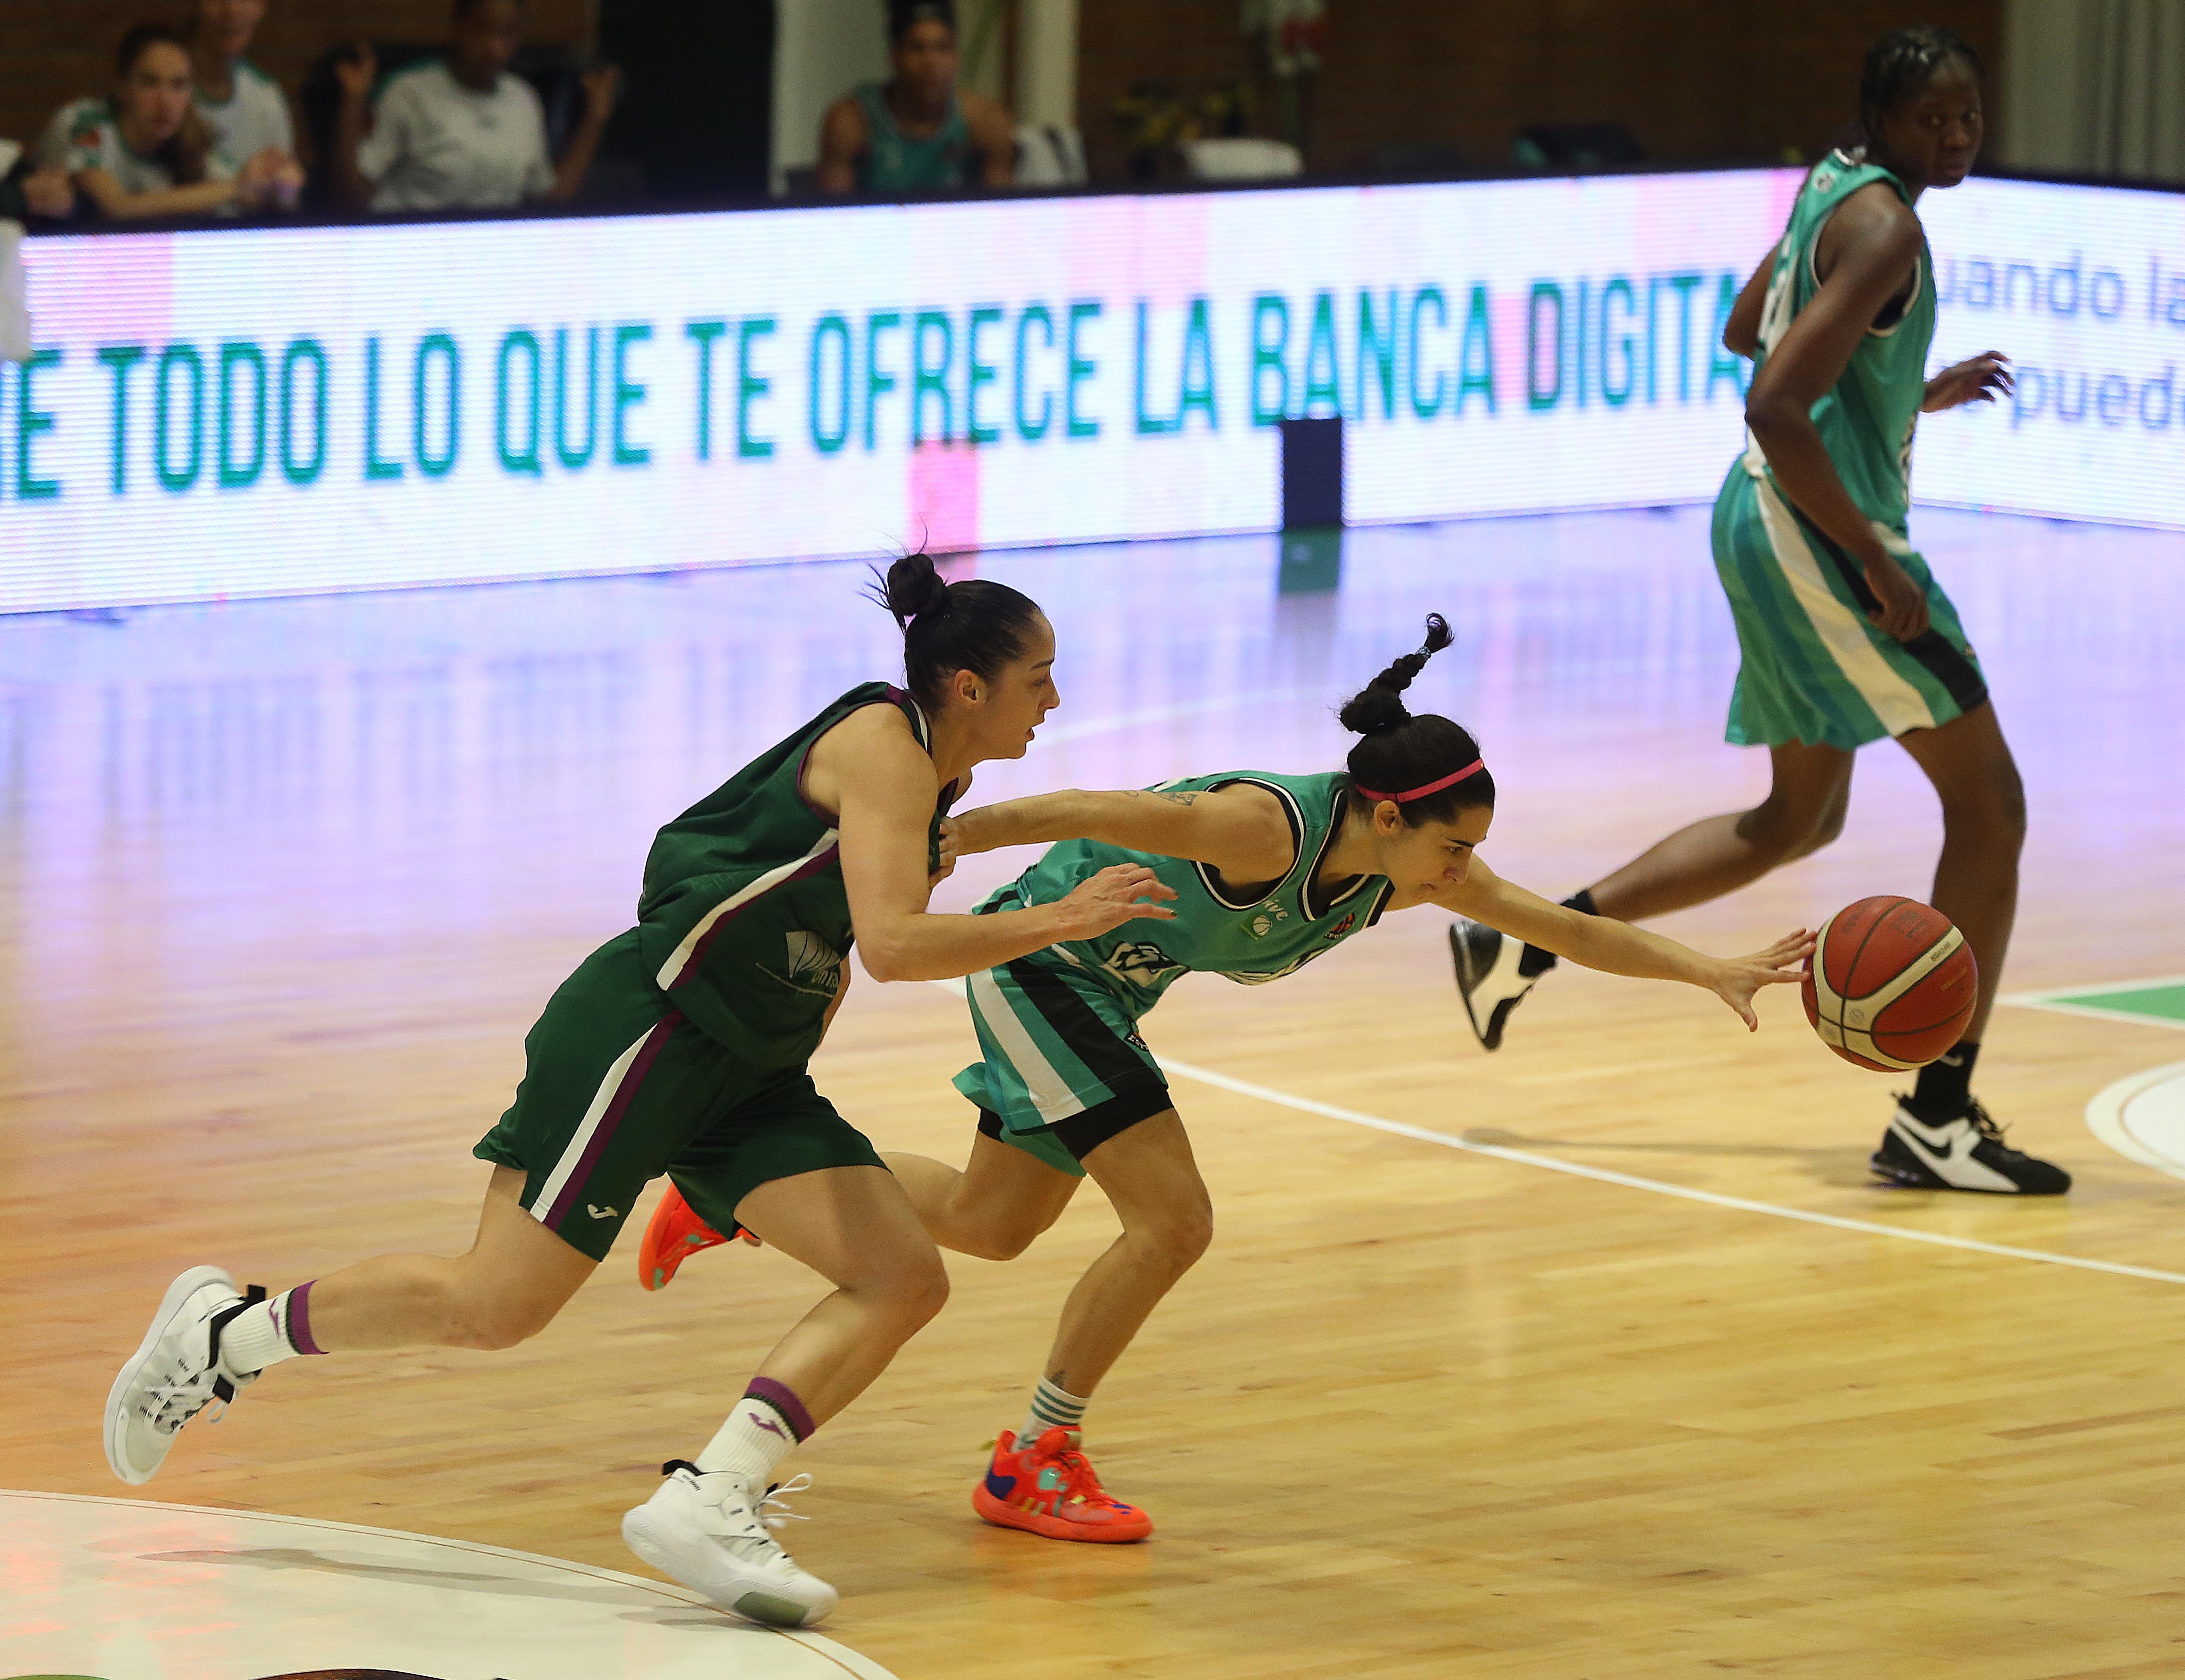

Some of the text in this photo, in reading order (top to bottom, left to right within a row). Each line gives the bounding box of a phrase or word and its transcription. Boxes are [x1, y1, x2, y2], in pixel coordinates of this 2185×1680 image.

[0, 347, 62, 500] E
[94, 338, 331, 496] TODO
[362, 331, 462, 482] LO
[494, 323, 654, 479] QUE
[684, 316, 778, 460] TE
[809, 300, 1102, 456] OFRECE
[1134, 296, 1219, 436] LA
[1249, 282, 1497, 426] BANCA
[2010, 361, 2185, 430] pued
